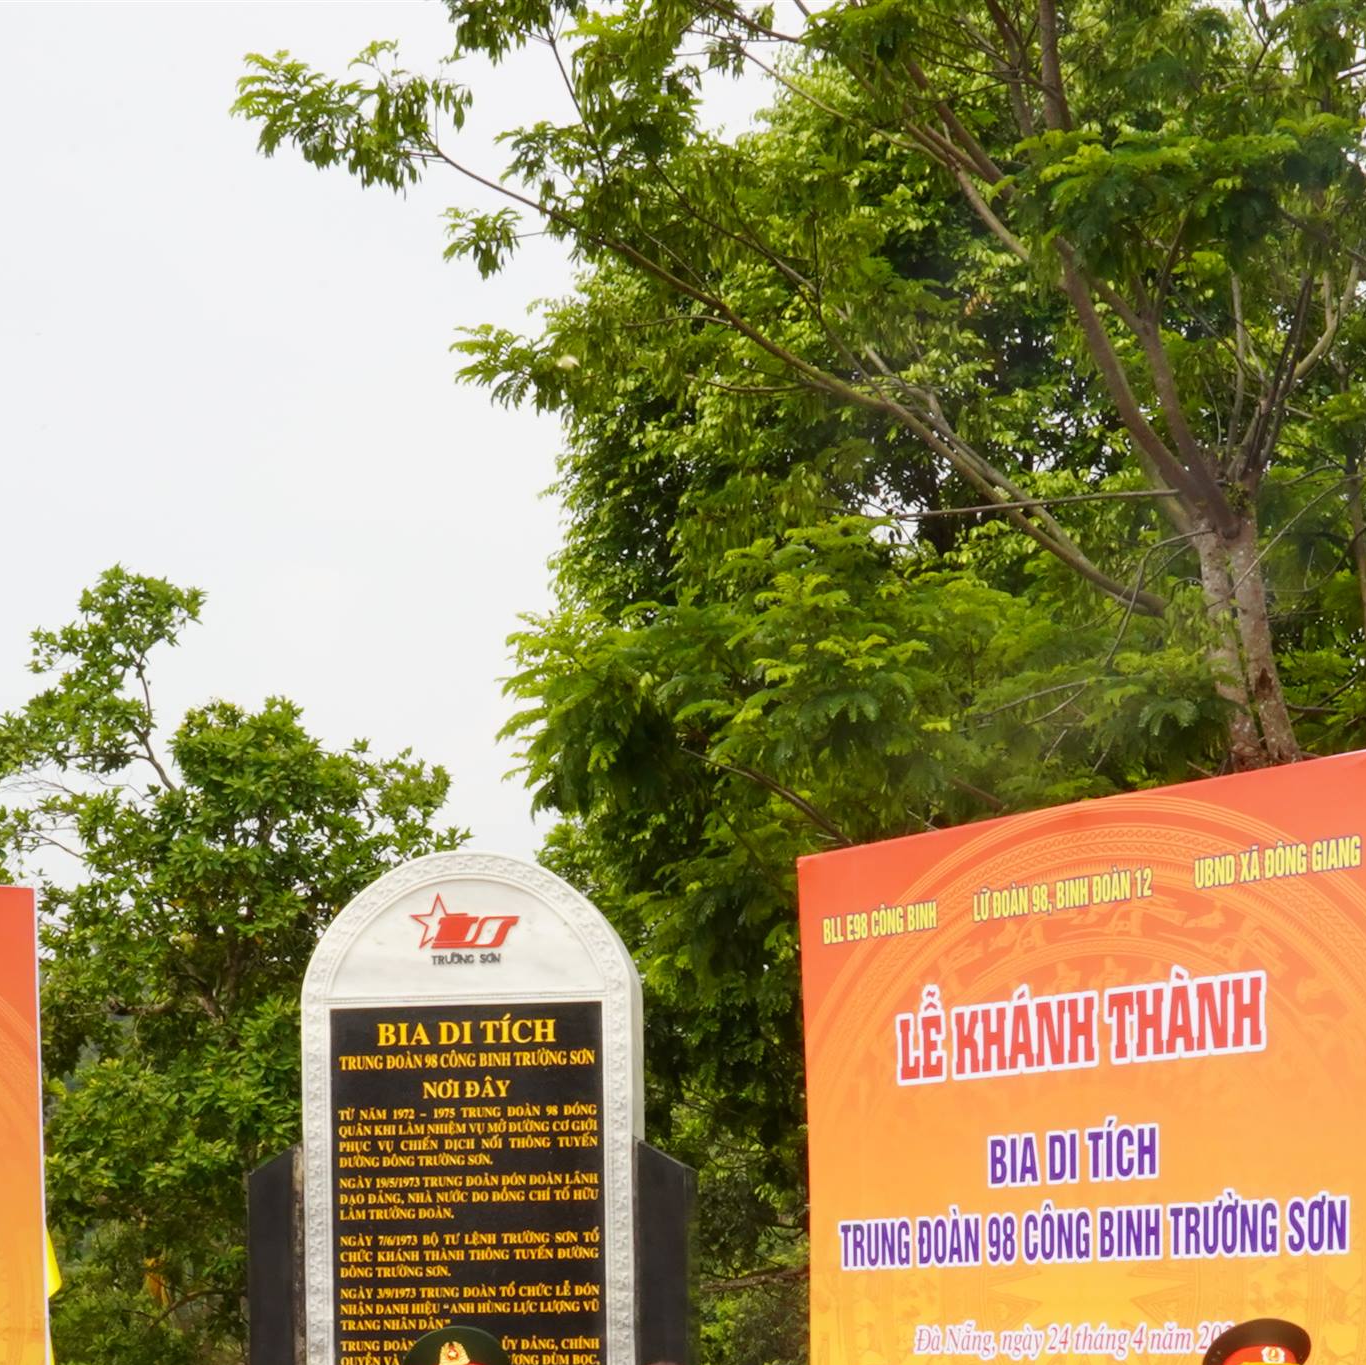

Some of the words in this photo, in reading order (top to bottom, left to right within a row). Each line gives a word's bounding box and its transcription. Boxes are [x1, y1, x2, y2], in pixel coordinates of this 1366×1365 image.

[1194, 854, 1236, 890] UBND
[1239, 842, 1261, 884] XÃ
[1263, 841, 1308, 880] ĐÔNG
[1311, 835, 1362, 873] GIANG
[972, 887, 991, 923] LỮ
[991, 882, 1029, 920] ĐOÀN
[1031, 883, 1053, 916] 98,
[1055, 876, 1090, 911] BINH
[1091, 868, 1132, 906] ĐOÀN
[1134, 867, 1153, 899] 12
[822, 917, 845, 945] BLL
[846, 914, 869, 942] E98
[870, 906, 905, 938] CÔNG
[906, 901, 938, 933] BINH
[377, 1022, 431, 1046] BIA
[438, 1020, 473, 1046] DI
[480, 1013, 556, 1045] TÍCH
[899, 986, 945, 1081] LỄ
[954, 990, 1097, 1074] KHÁNH
[1106, 970, 1265, 1056] THÀNH
[339, 1055, 383, 1071] TRUNG
[386, 1052, 425, 1070] ĐOÀN
[425, 1054, 437, 1069] 98
[440, 1050, 476, 1068] CÔNG
[479, 1052, 511, 1067] BINH
[514, 1048, 566, 1067] TRƯỜNG
[570, 1048, 595, 1065] SƠN
[422, 1079, 459, 1099] NƠI
[465, 1075, 510, 1099] ĐÂY
[990, 1135, 1038, 1185] BIA
[1048, 1132, 1077, 1181] DI
[1087, 1119, 1157, 1178] TÍCH
[840, 1219, 911, 1267] TRUNG
[918, 1208, 980, 1265] ĐOÀN
[989, 1215, 1016, 1261] 98
[1024, 1206, 1090, 1260] CÔNG
[1099, 1208, 1160, 1257] BINH
[1169, 1190, 1277, 1254] TRƯỜNG
[1289, 1196, 1348, 1251] SƠN
[917, 1325, 941, 1351] Đà
[946, 1321, 996, 1357] Nẵng,
[1001, 1326, 1043, 1357] ngày
[1047, 1325, 1069, 1350] 24
[1075, 1324, 1128, 1358] tháng
[1133, 1324, 1144, 1350] 4
[1151, 1324, 1192, 1350] năm
